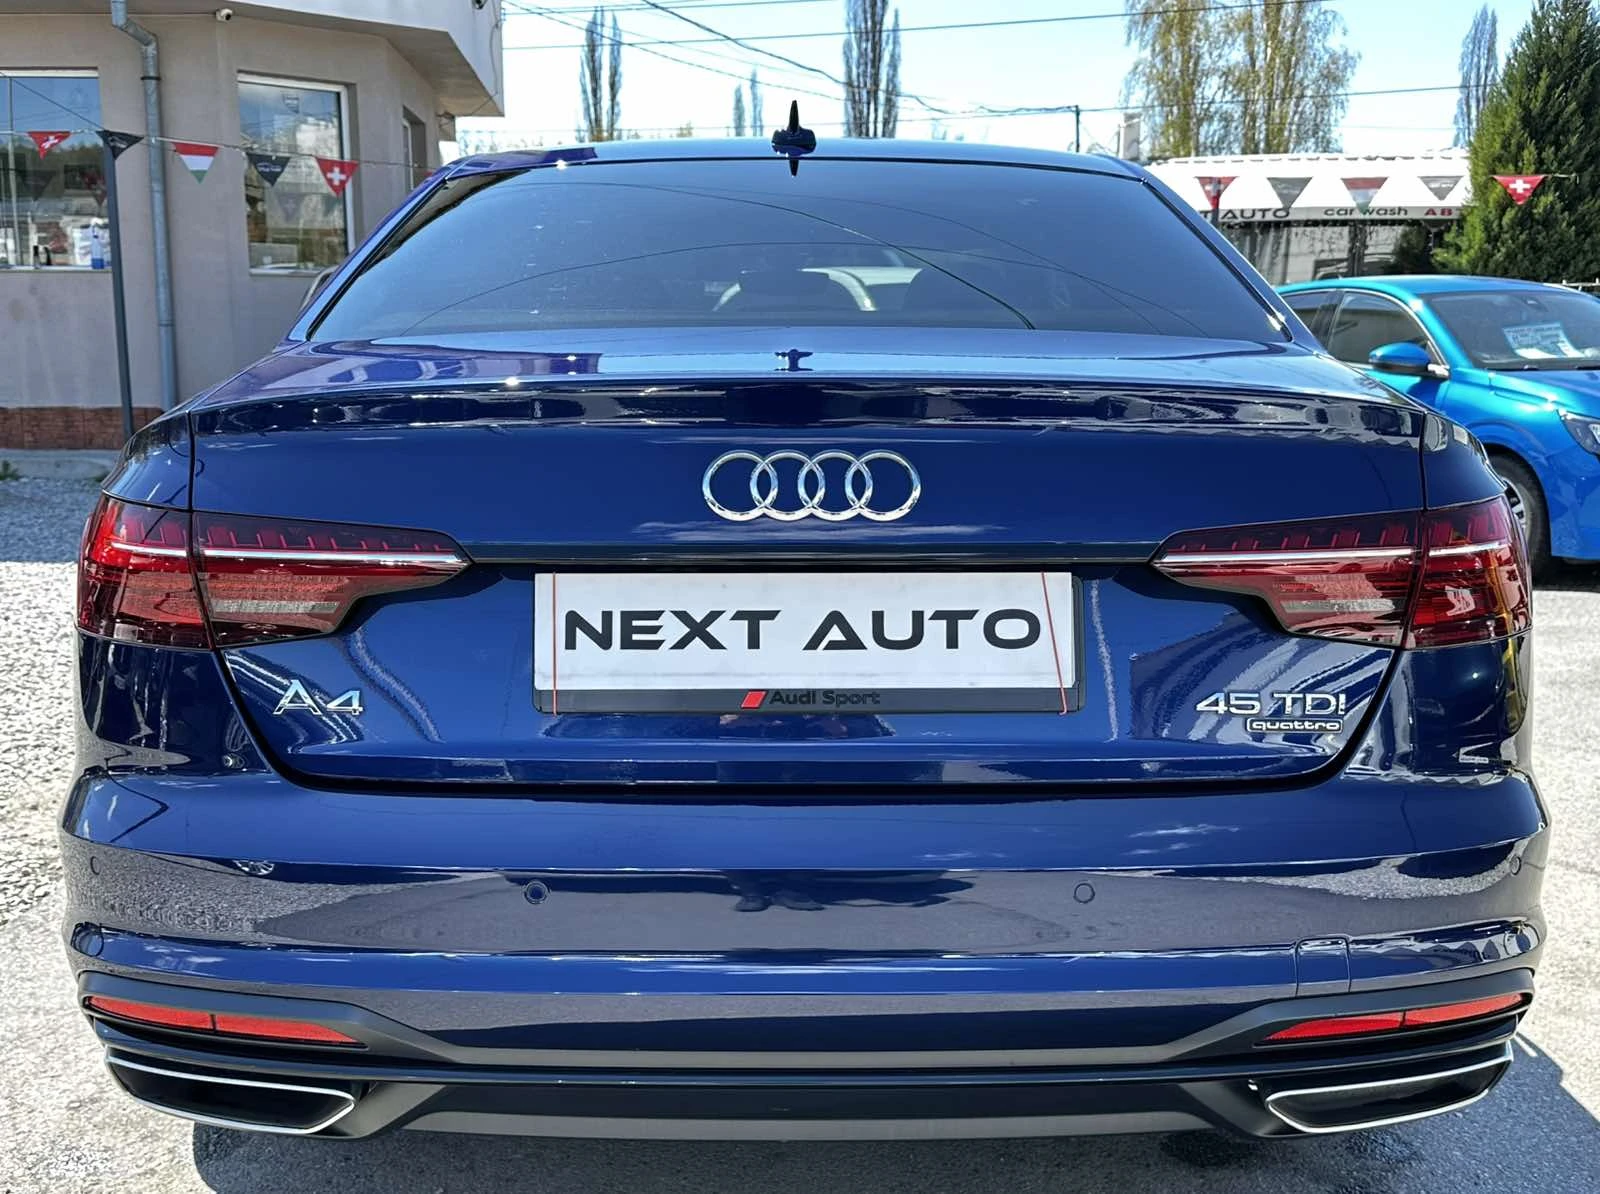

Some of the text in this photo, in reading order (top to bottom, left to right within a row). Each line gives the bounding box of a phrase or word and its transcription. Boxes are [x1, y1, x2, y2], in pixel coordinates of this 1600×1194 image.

[1221, 208, 1290, 220] AUTO
[1323, 207, 1354, 216] car
[564, 608, 1041, 651] NEXT AUTO
[272, 679, 364, 716] A4
[769, 690, 881, 707] Audi Sport
[1196, 692, 1346, 715] 45 TDI
[1251, 720, 1340, 731] quattro
